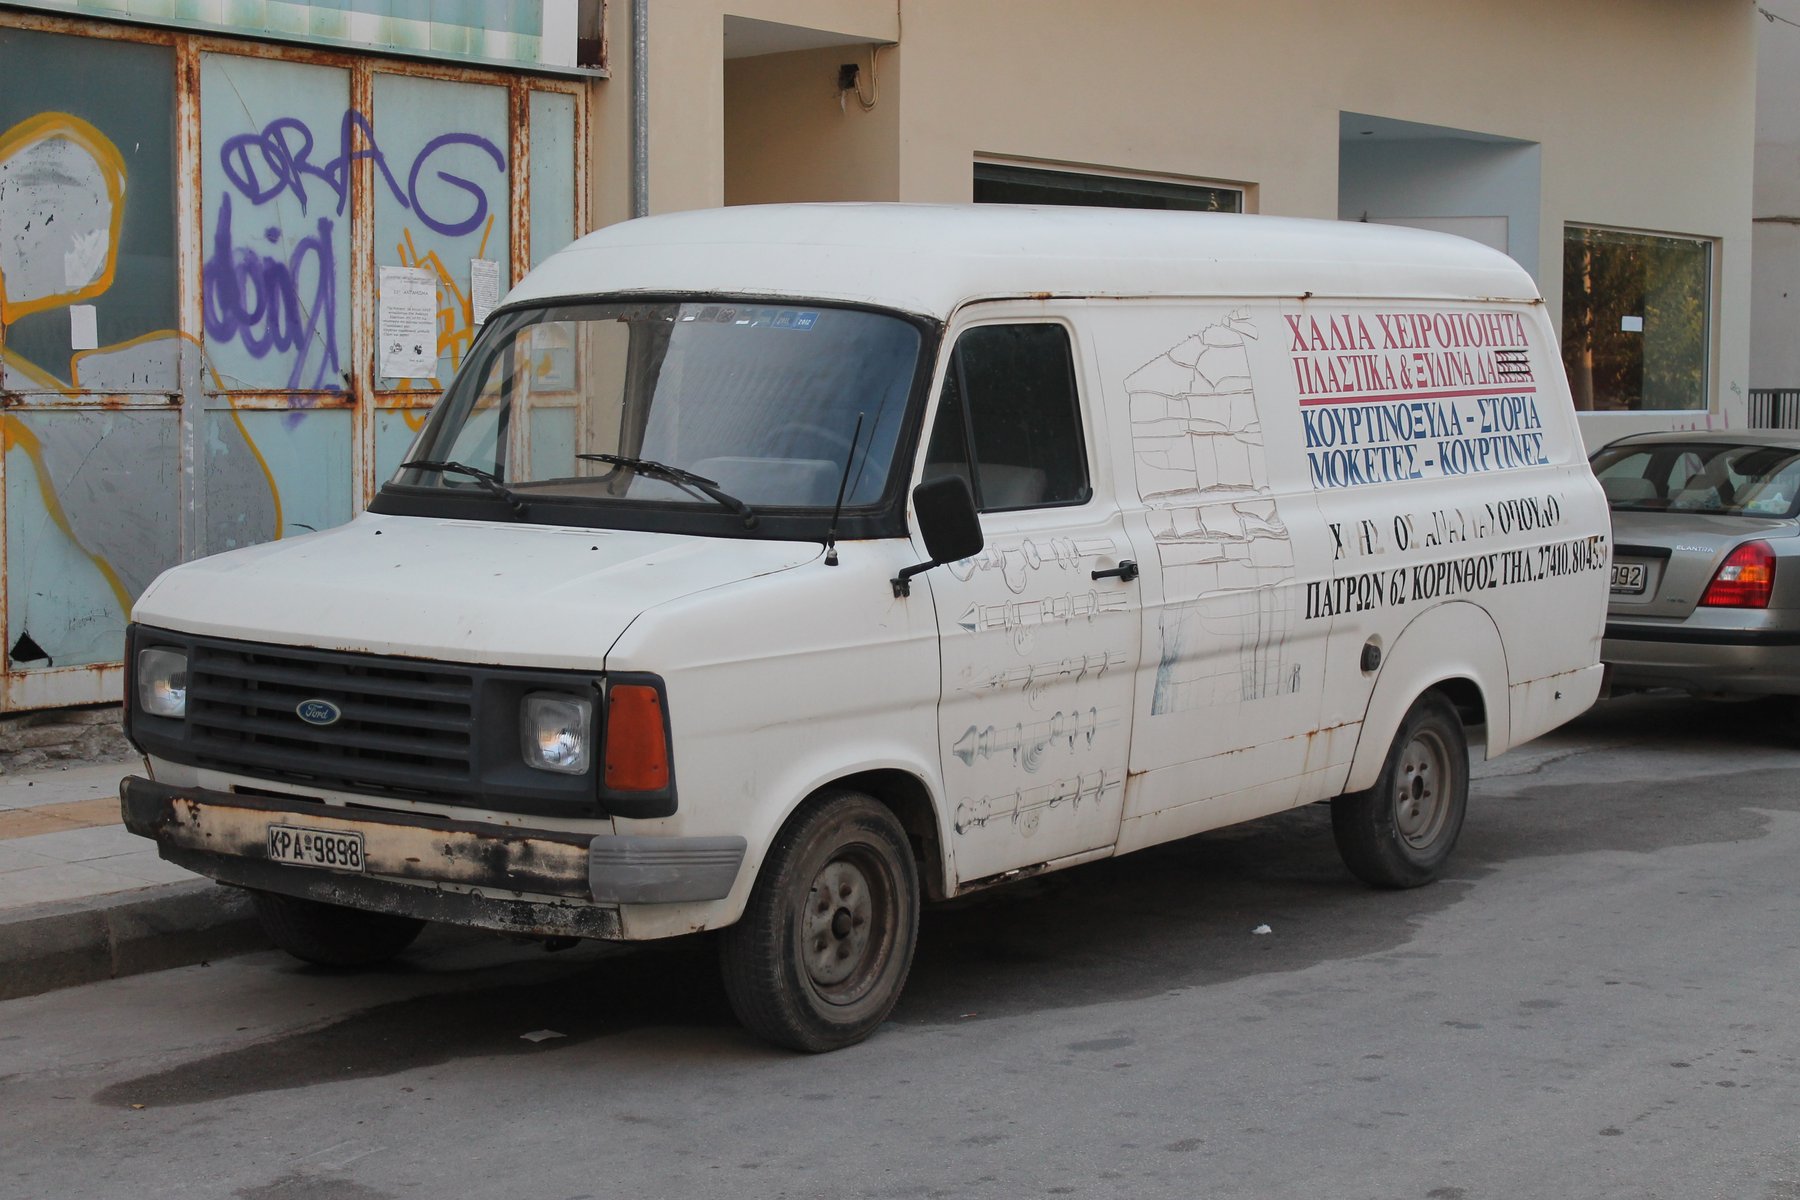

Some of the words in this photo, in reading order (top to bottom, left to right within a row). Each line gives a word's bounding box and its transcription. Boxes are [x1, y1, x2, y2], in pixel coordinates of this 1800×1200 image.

[1284, 314, 1376, 351] ΧΑΛΙΑ
[1376, 312, 1529, 350] ΧΕΙΡΟΠΟΙΗΤΑ
[1293, 354, 1398, 394] ΠΛΑΣΤΙΚΑ
[1400, 354, 1413, 390] &
[1413, 351, 1475, 388] ΞΥΛΙΝΑ
[1301, 401, 1463, 448] ΚΟΥΡΤΙΝΟΞΥΛΑ
[1477, 396, 1541, 433] ΣΤΟΡΙΑ
[1307, 444, 1423, 489] ΜΟΚΕΤΕΣ
[1437, 432, 1550, 475] ΚΟΥΡΤΙΝΕΣ
[1676, 544, 1714, 553] ELANTRA
[1305, 571, 1385, 619] ΠΑΤΡΩΝ
[1390, 568, 1406, 606] 62
[1411, 554, 1498, 601] ΚΟΡΙΝΘΟΣ
[305, 703, 328, 720] Ford
